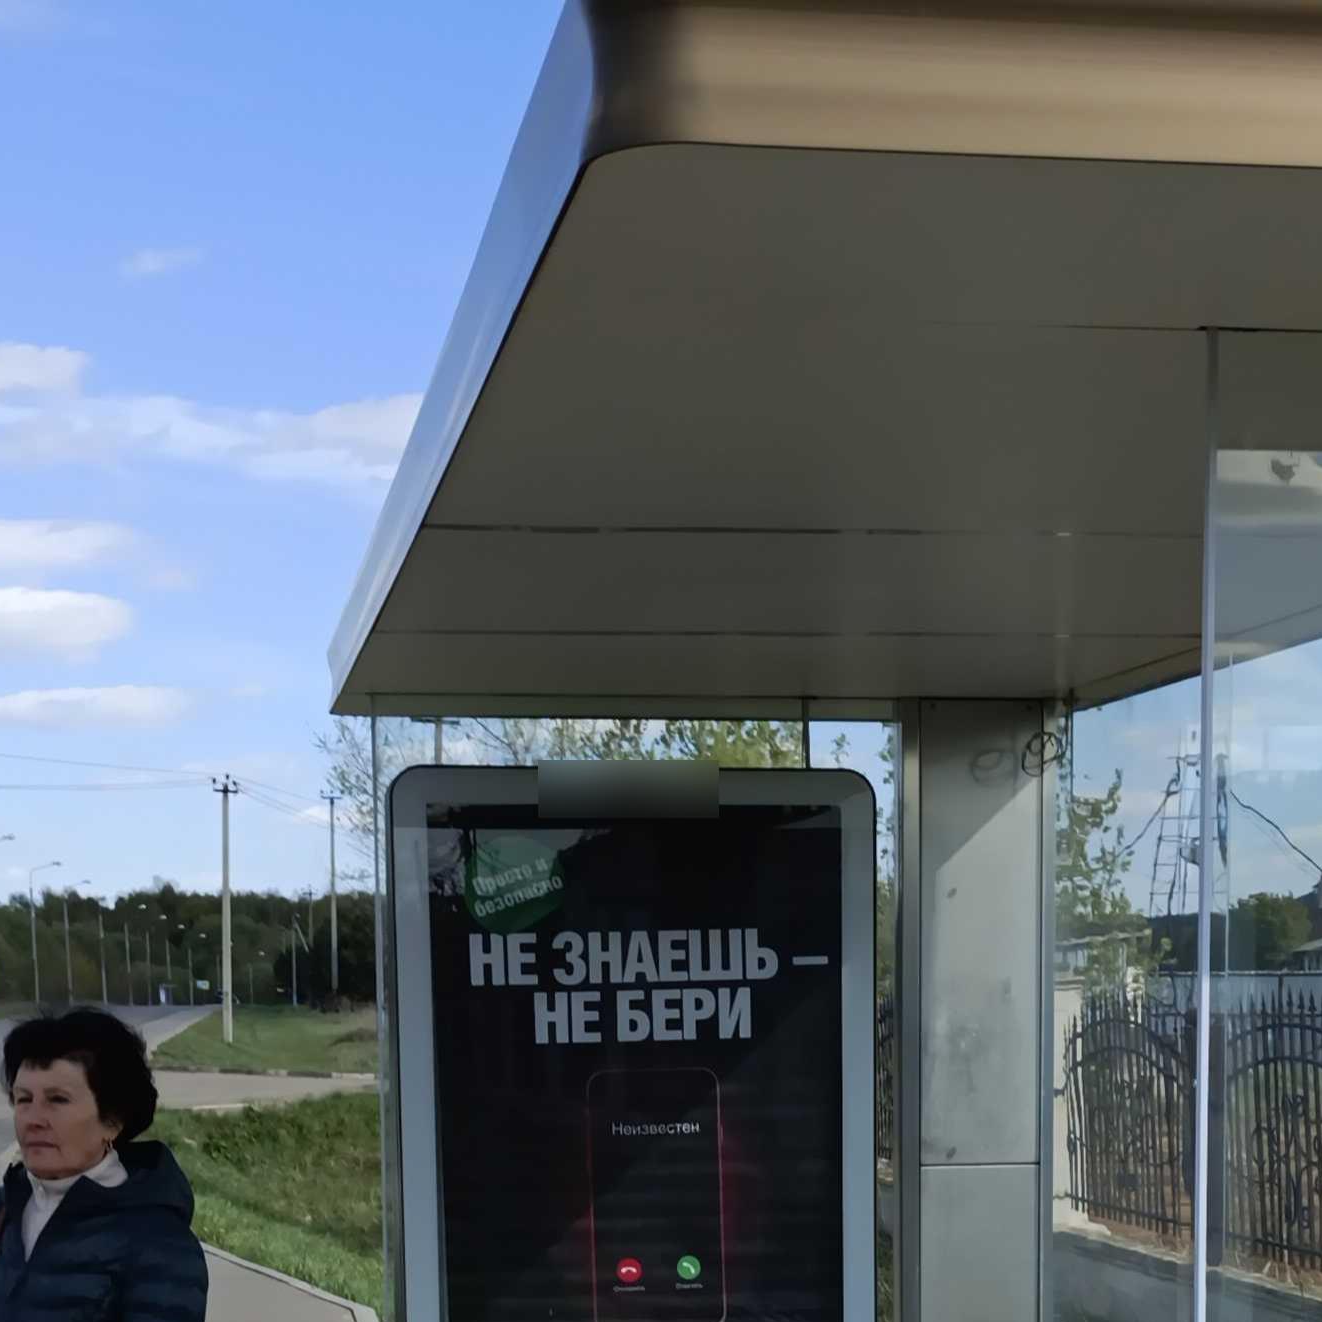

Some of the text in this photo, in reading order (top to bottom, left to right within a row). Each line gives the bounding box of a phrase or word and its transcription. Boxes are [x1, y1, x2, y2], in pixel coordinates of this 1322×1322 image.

[472, 864, 533, 896] Просто
[474, 876, 564, 917] безопасно
[469, 932, 539, 986] НЕ
[552, 928, 778, 985] ЗНАЕШЬ
[533, 987, 752, 1044] НЕ БЕРИ
[611, 1121, 701, 1137] Неизвестен
